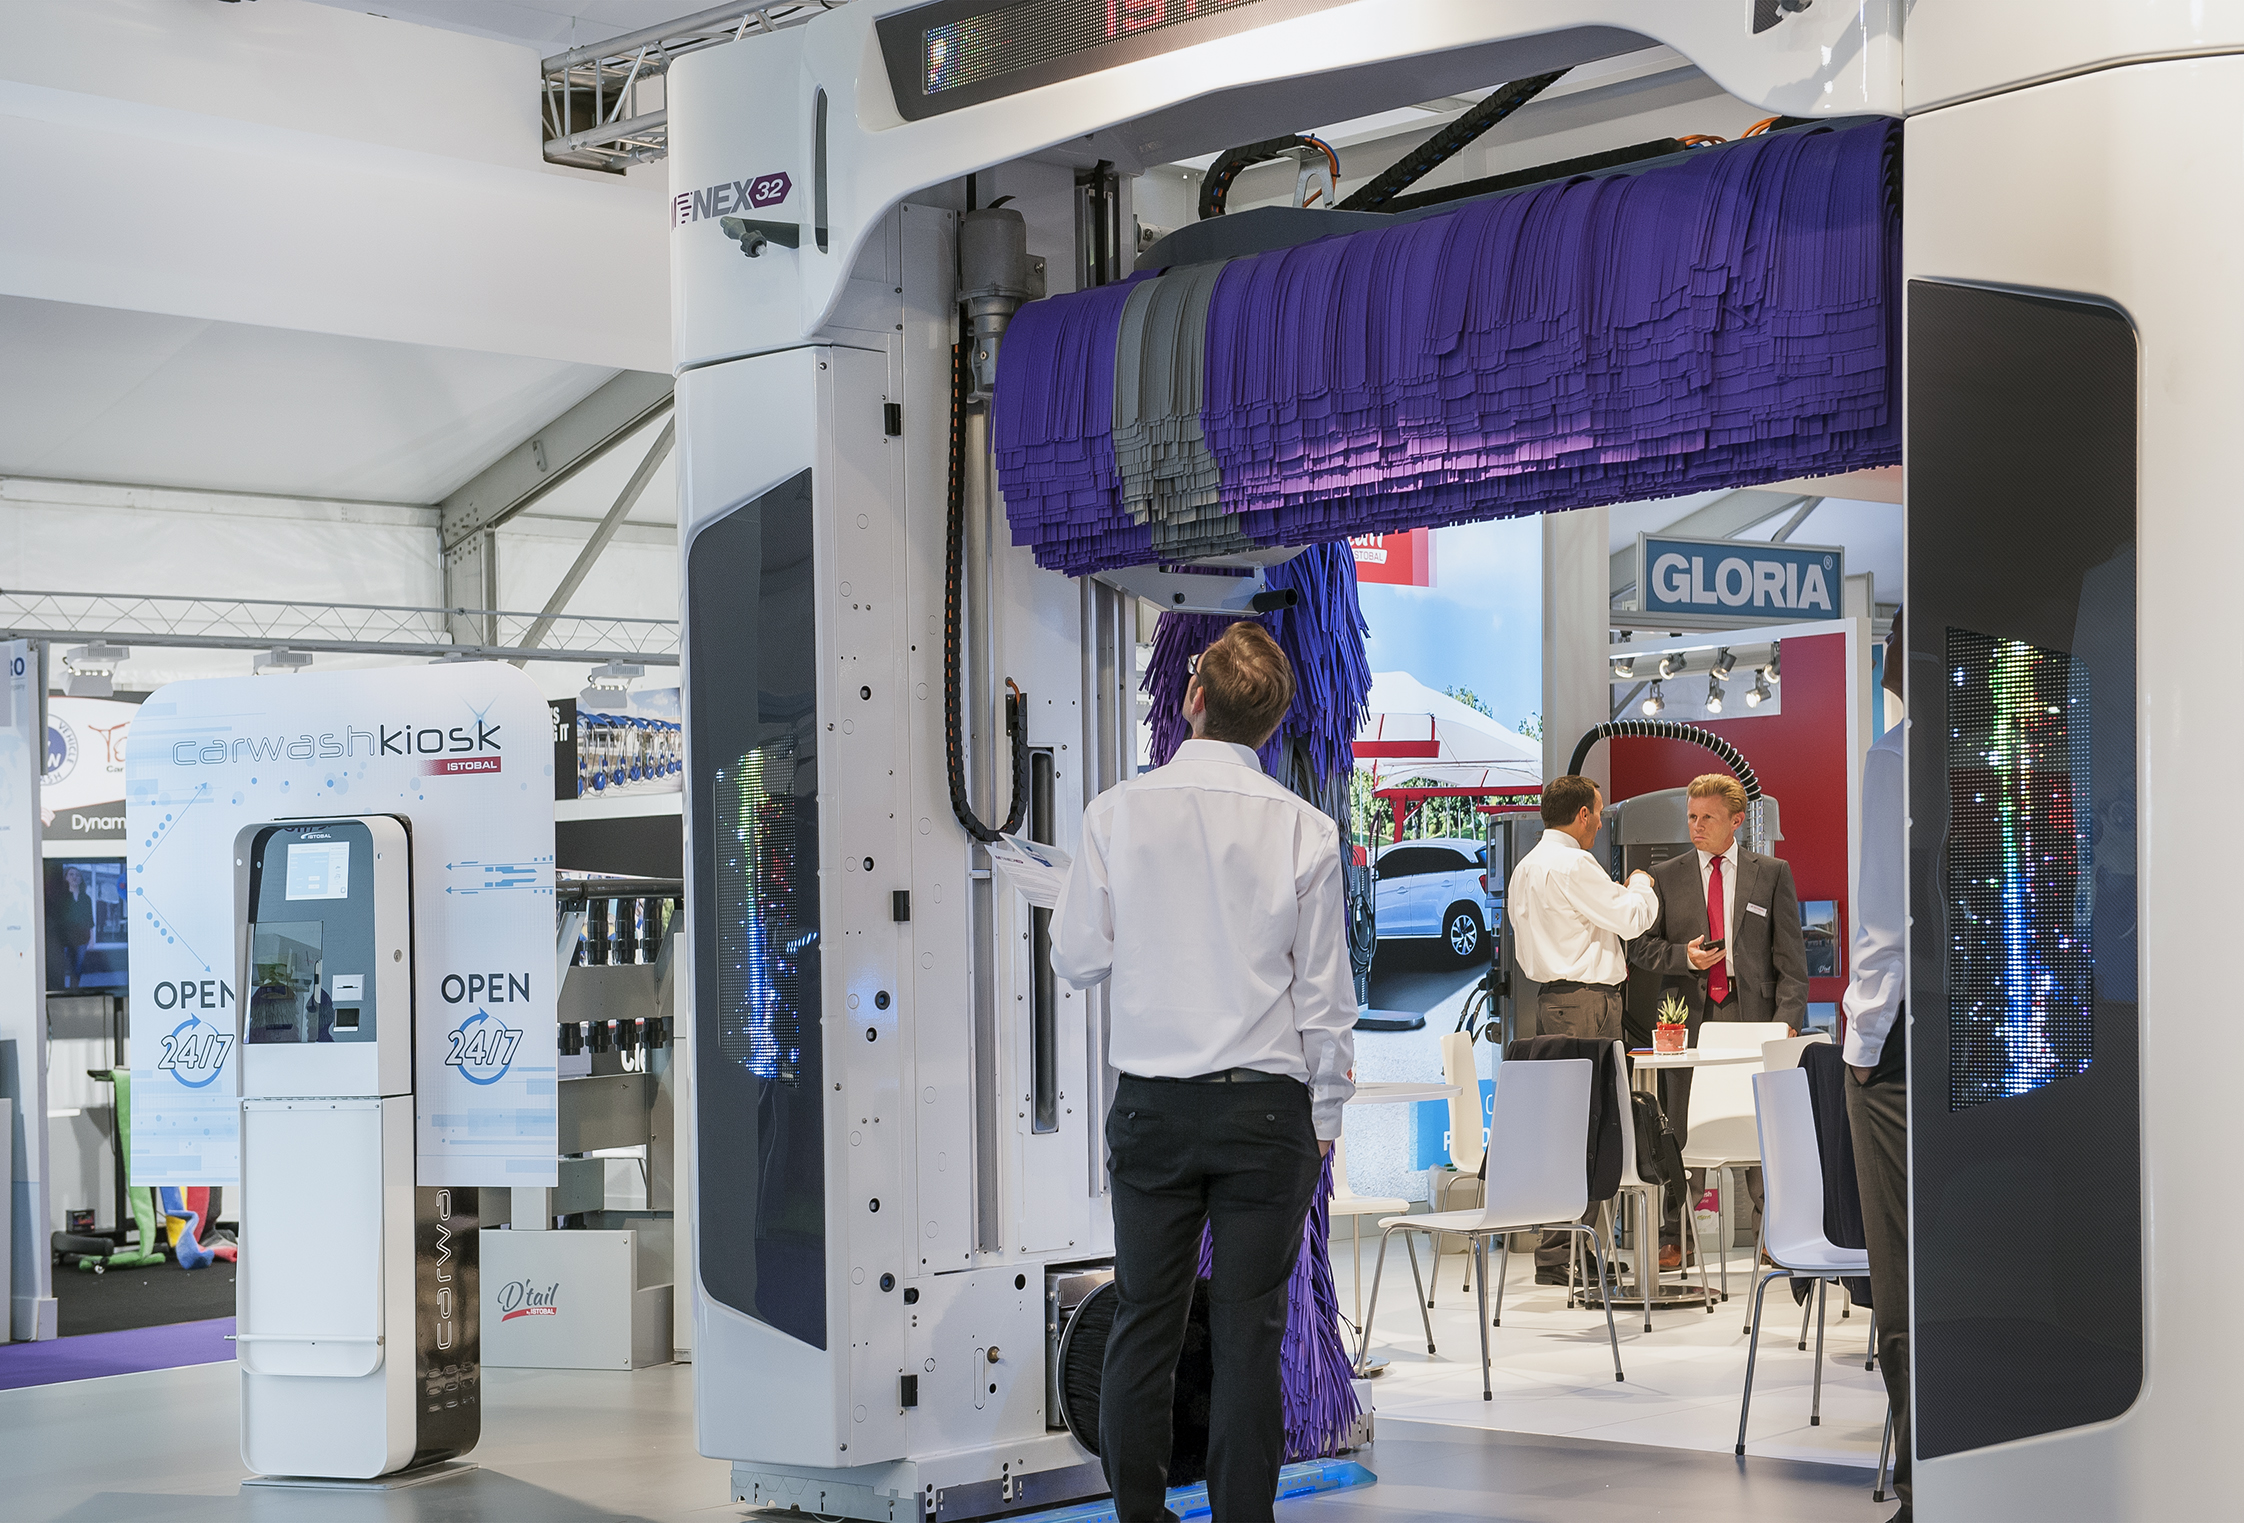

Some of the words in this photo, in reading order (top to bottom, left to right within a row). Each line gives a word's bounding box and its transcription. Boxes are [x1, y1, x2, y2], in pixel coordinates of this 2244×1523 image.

[755, 179, 784, 201] 32
[1353, 550, 1384, 562] STOBAL
[1652, 553, 1832, 611] GLORIA
[172, 721, 501, 766] carwashkiosk
[559, 723, 570, 742] IT
[446, 761, 498, 771] ISTOBAL
[441, 972, 530, 1004] OPEN
[158, 1033, 235, 1070] 24/7
[444, 1029, 524, 1066] 24/7
[497, 1278, 560, 1313] D'tail
[530, 1308, 555, 1316] ISTOBAL
